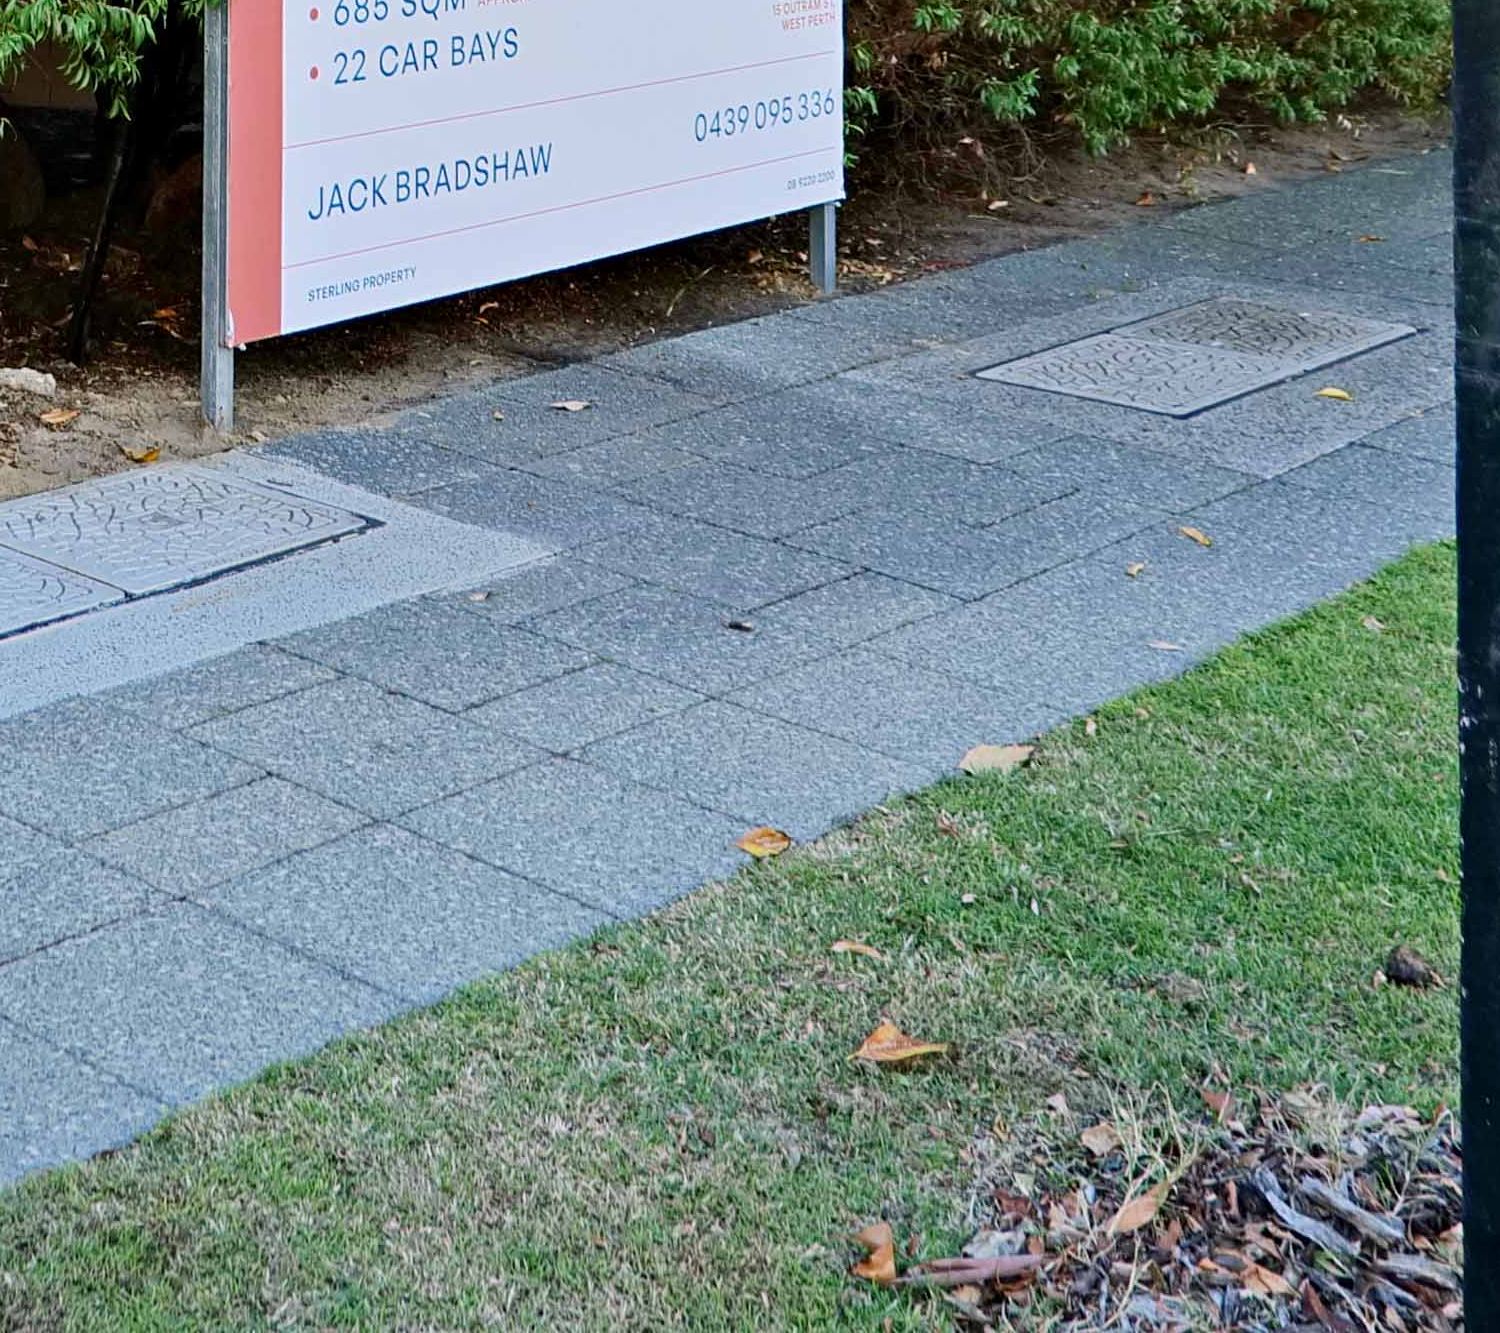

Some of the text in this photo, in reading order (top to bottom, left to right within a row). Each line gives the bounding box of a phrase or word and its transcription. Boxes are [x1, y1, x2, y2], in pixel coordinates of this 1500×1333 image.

[334, 27, 518, 85] 22 CAR BAYS
[695, 88, 835, 142] 0439 095 336
[308, 143, 552, 220] JACK BRADSHAW
[308, 265, 417, 302] STERLING PROPERTY
